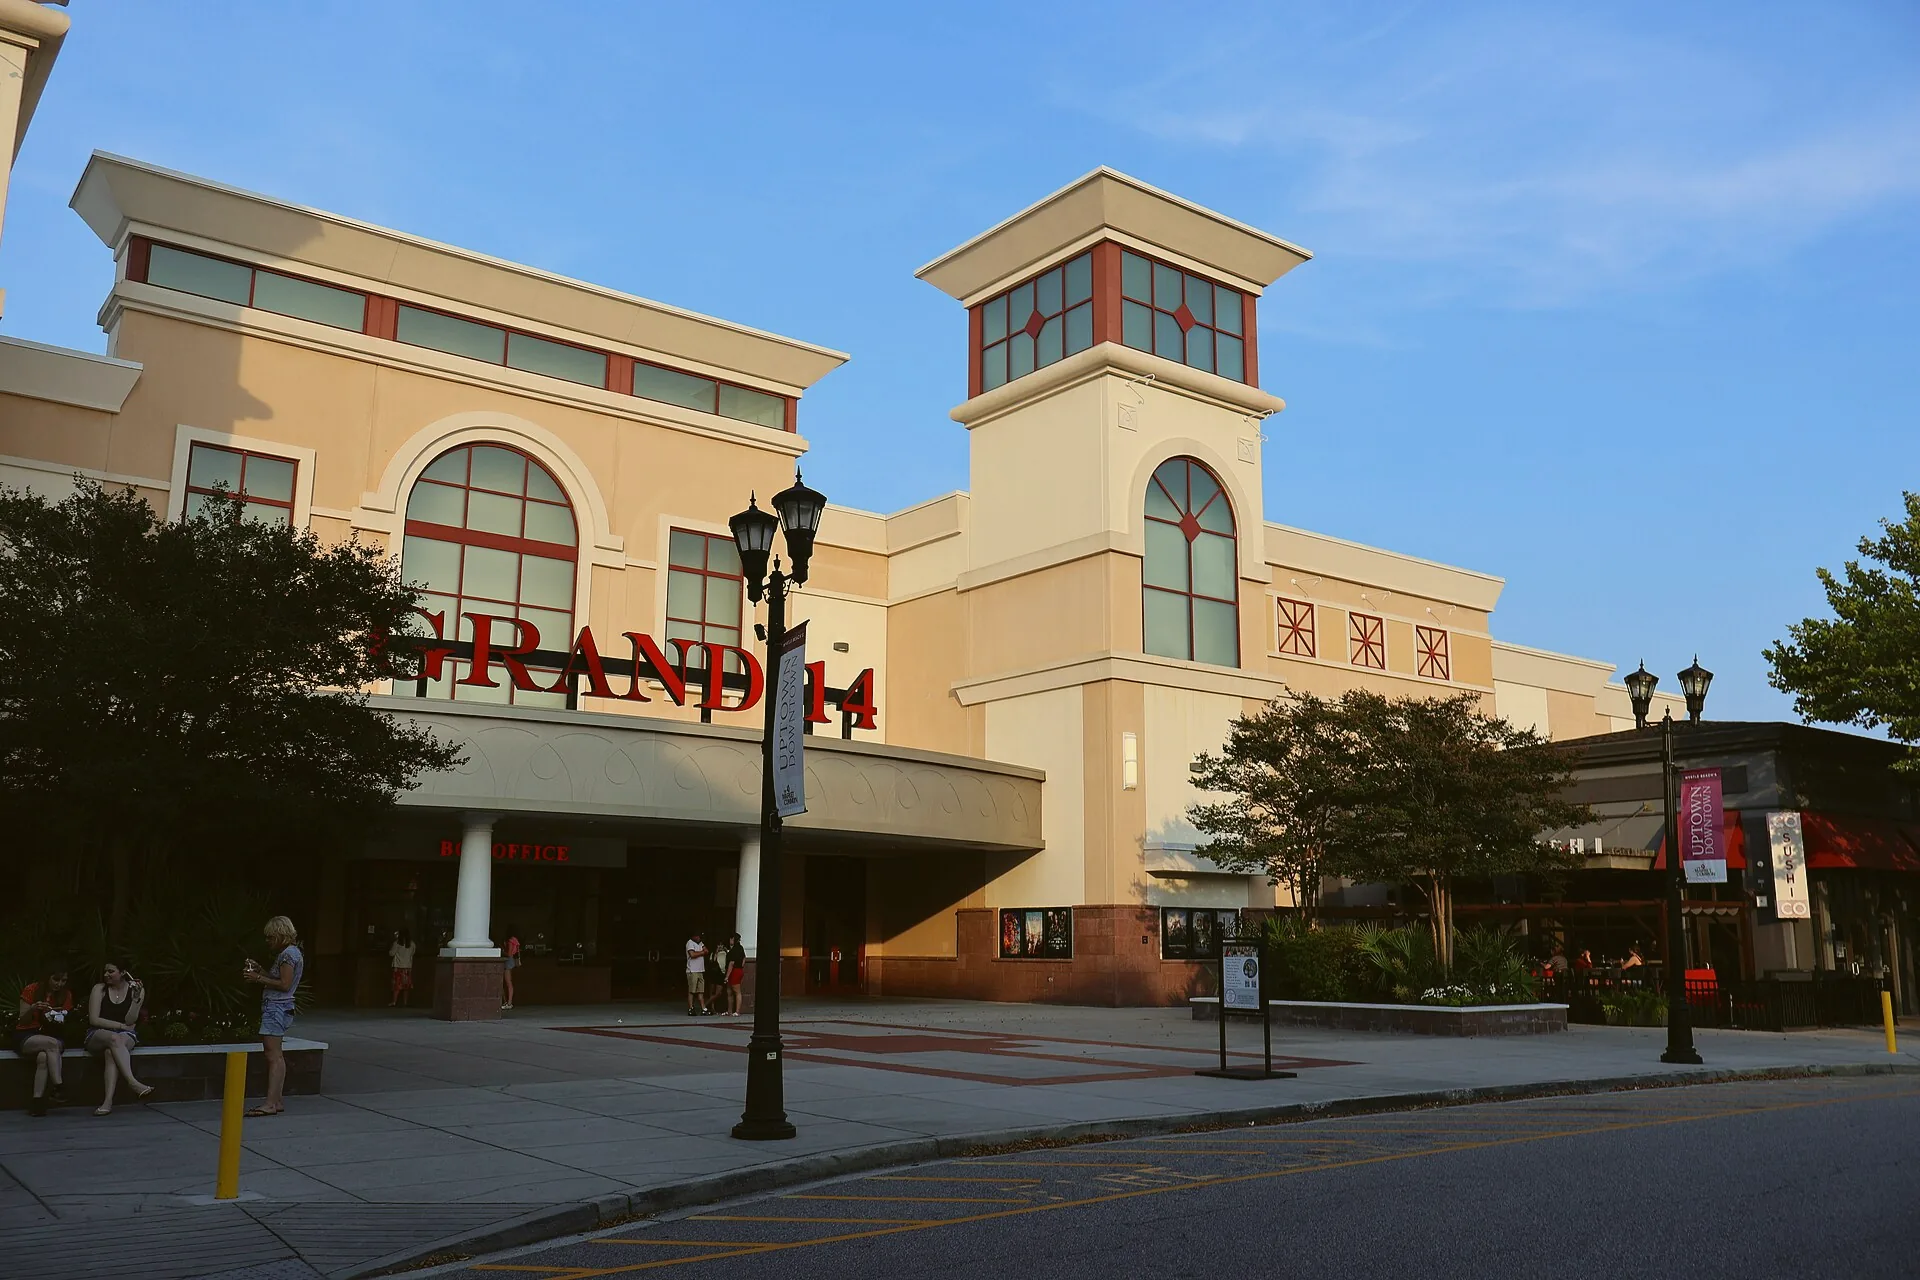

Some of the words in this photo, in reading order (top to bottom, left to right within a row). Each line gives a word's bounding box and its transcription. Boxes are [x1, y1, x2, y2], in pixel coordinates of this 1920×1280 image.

[368, 604, 764, 711] GRAND
[804, 660, 878, 730] 14
[780, 658, 790, 770] UPTOWN
[788, 655, 797, 767] DOWNTOWN
[491, 843, 570, 861] OFFICE
[1691, 786, 1704, 856] UPTOWN
[1702, 785, 1714, 855] DOWNTOWN
[1782, 832, 1795, 898] SUSHI
[1781, 902, 1806, 916] CO
